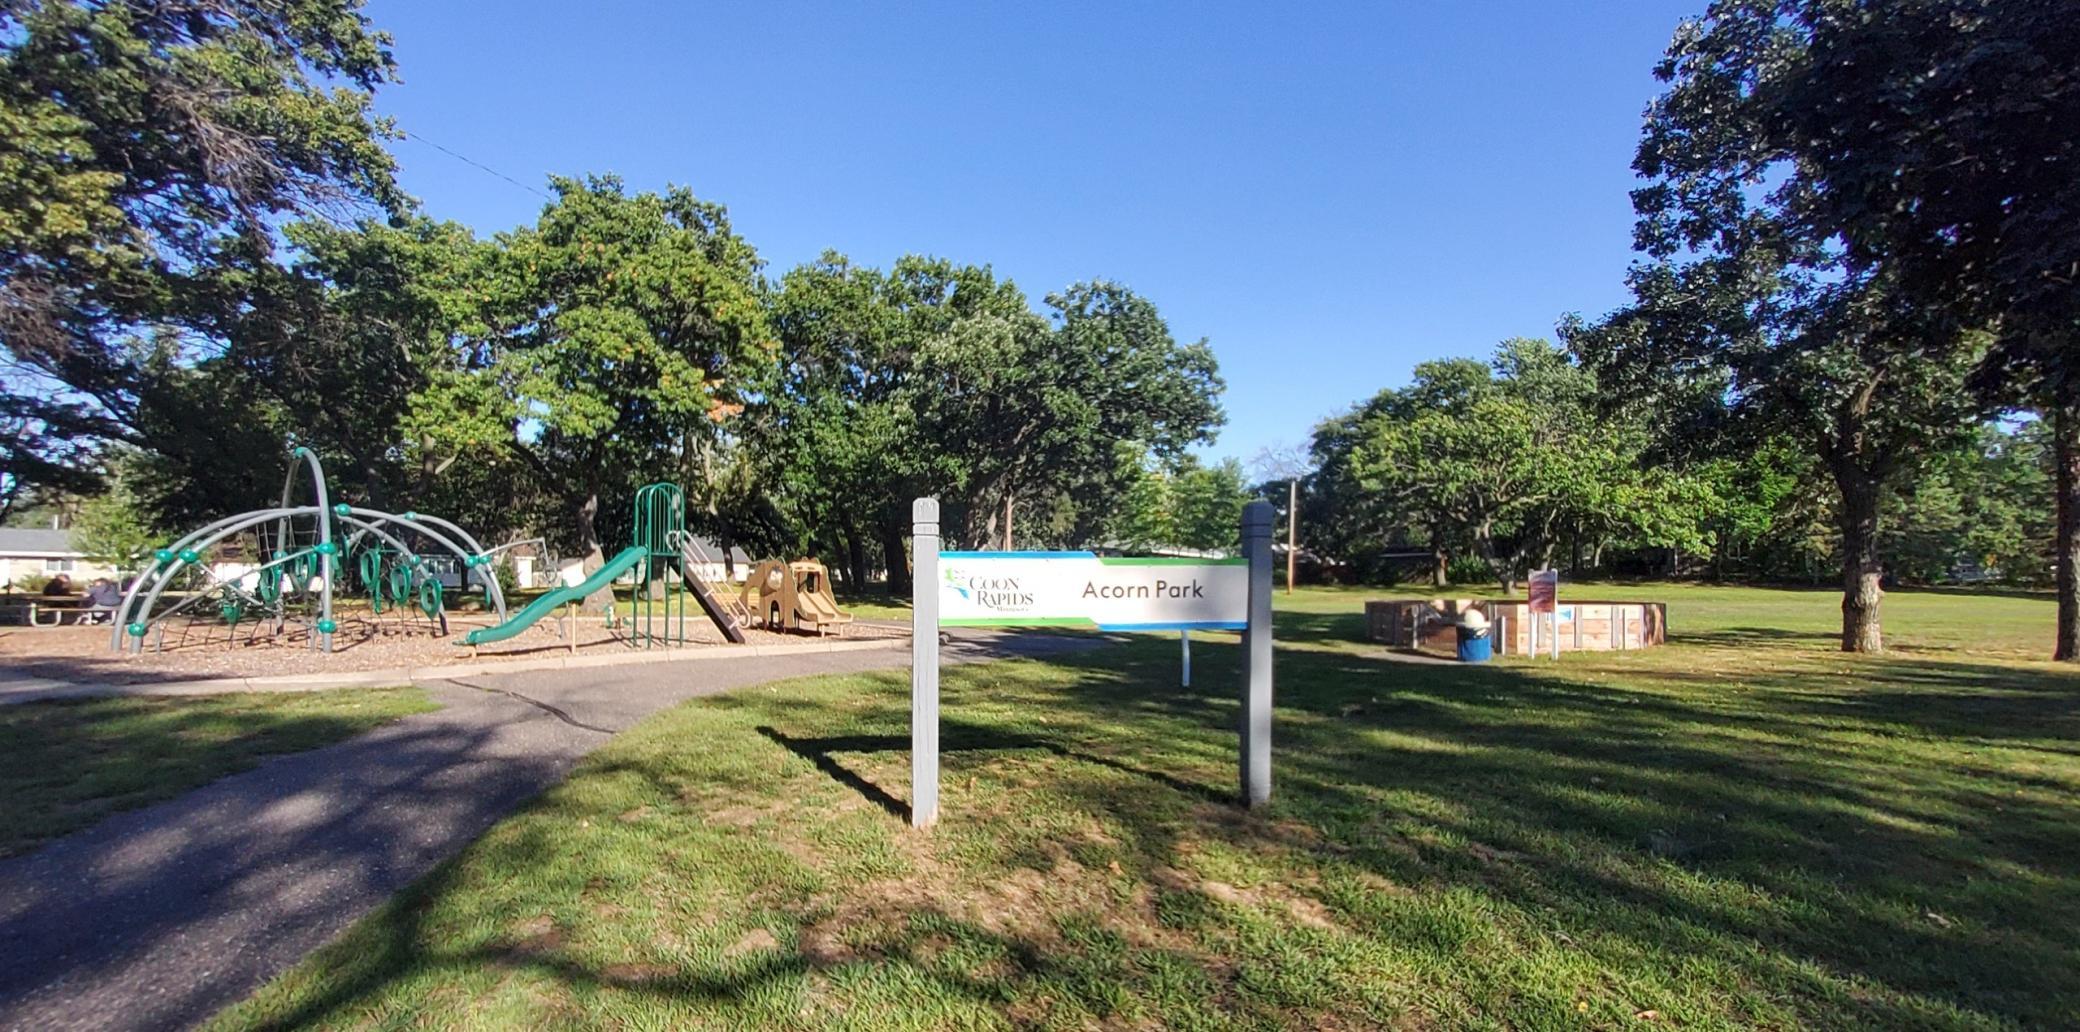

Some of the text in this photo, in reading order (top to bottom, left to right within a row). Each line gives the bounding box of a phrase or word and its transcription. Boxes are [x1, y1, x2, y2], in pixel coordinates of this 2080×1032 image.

[969, 577, 1019, 590] COON
[1082, 580, 1204, 599] Acorn Park
[978, 591, 1034, 608] RAPIDS
